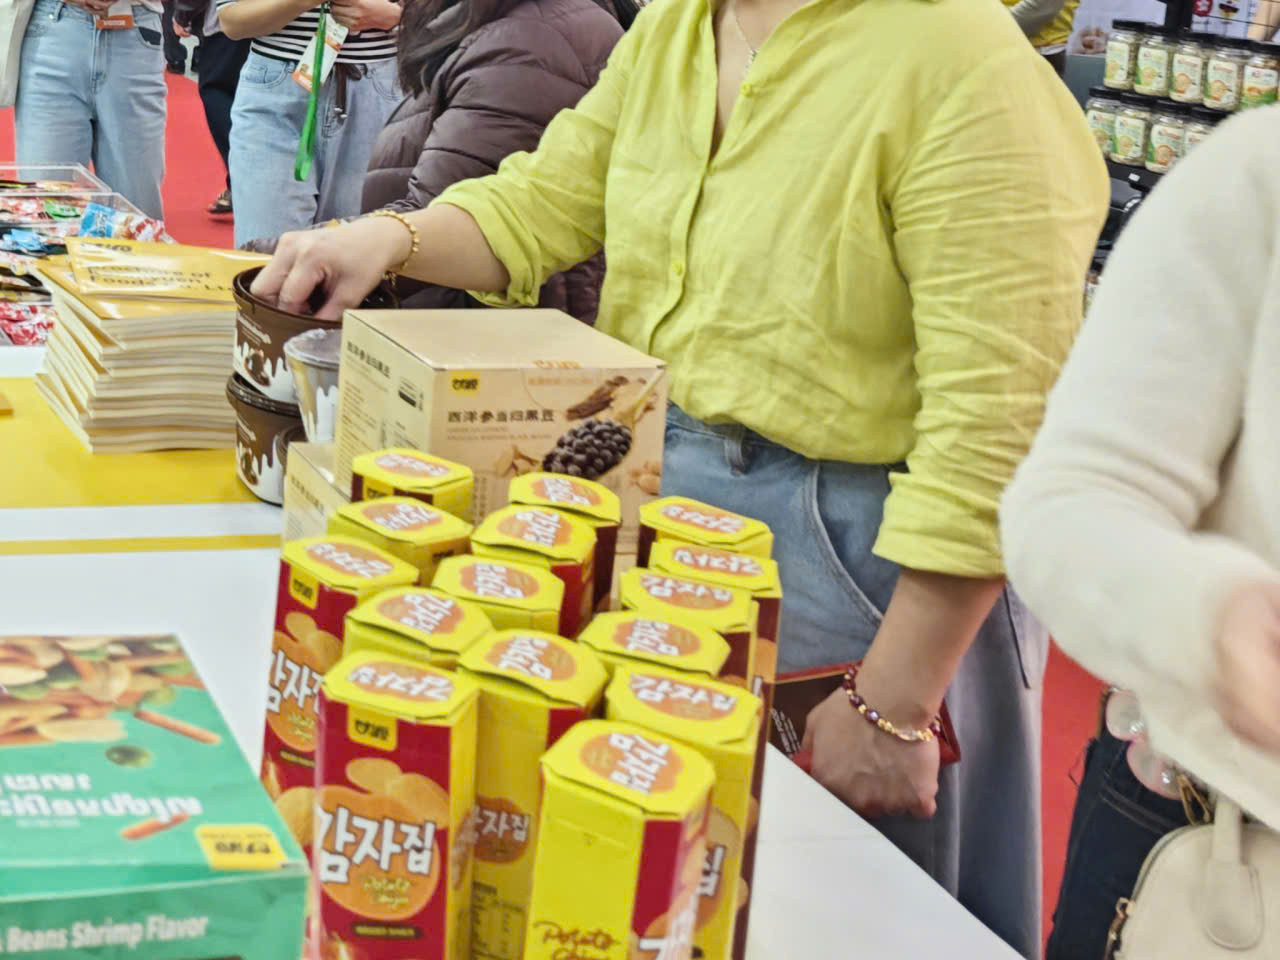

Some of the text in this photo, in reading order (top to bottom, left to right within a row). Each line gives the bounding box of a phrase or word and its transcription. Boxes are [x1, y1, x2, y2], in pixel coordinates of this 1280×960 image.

[446, 408, 555, 425] 西洋参当归黑豆
[7, 925, 69, 952] Beans
[71, 915, 145, 949] Shrimp
[146, 912, 210, 941] Flavor
